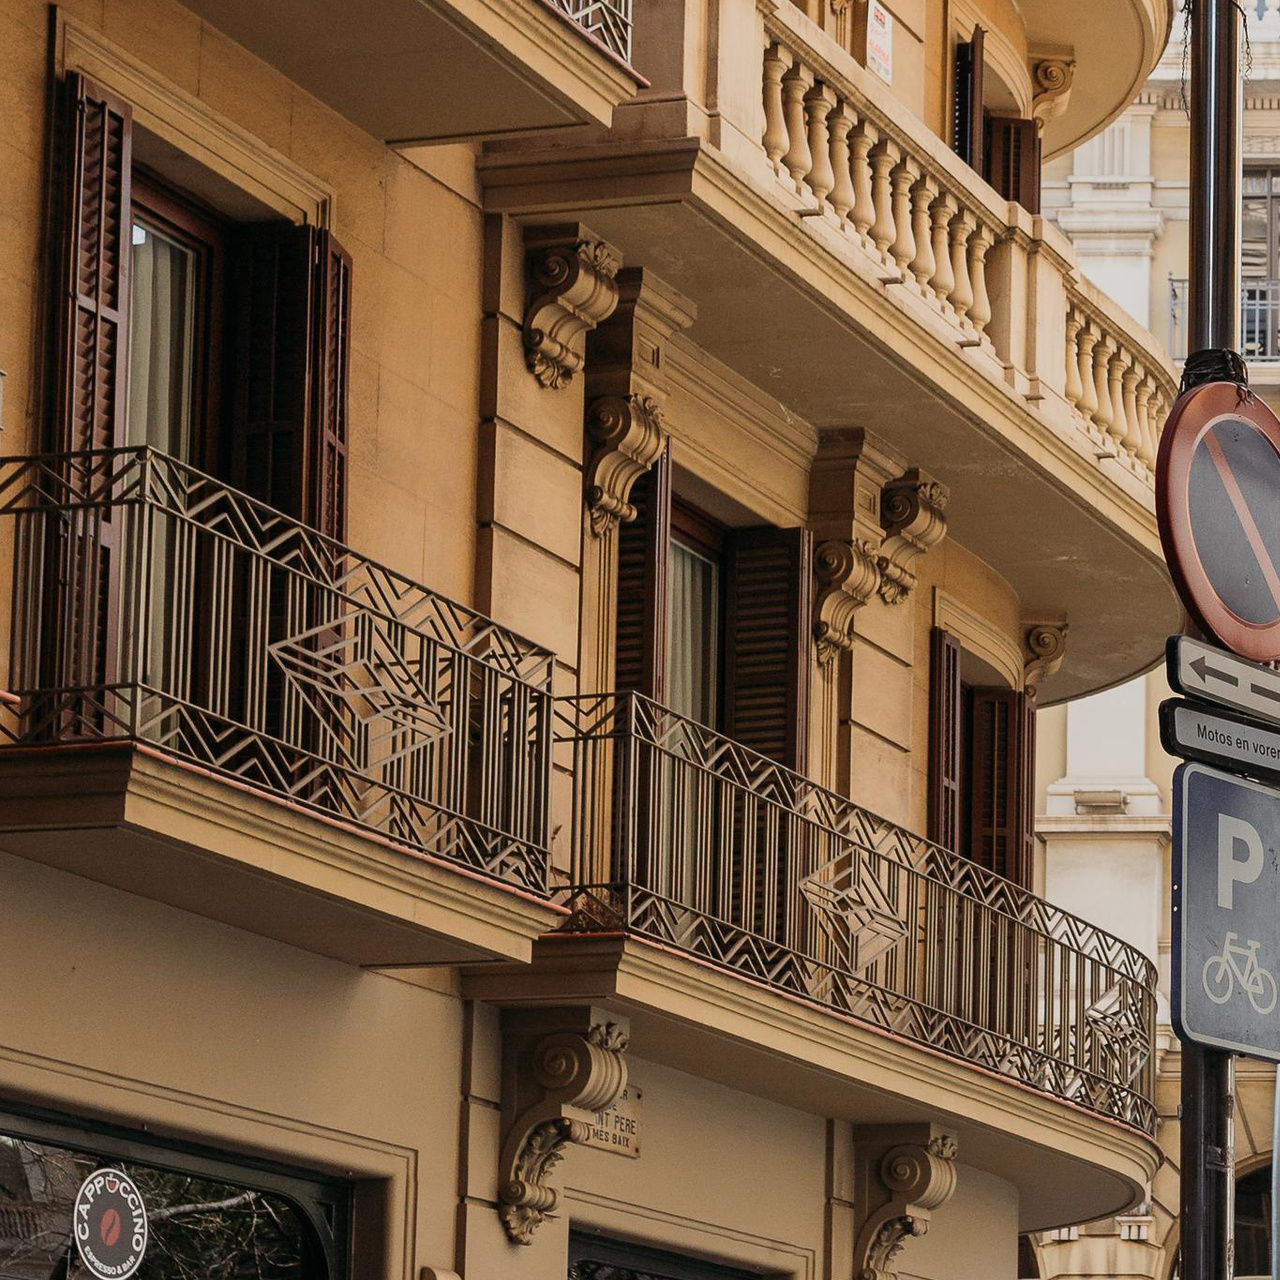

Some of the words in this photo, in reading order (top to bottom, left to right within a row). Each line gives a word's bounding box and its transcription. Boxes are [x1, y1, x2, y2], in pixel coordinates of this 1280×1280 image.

[1197, 723, 1232, 746] Motos
[1236, 737, 1249, 751] en
[1217, 812, 1264, 910] P
[614, 1115, 636, 1136] PERE
[612, 1133, 630, 1148] BAIX
[84, 1246, 117, 1275] ESPRESSO
[122, 1255, 136, 1272] BAR
